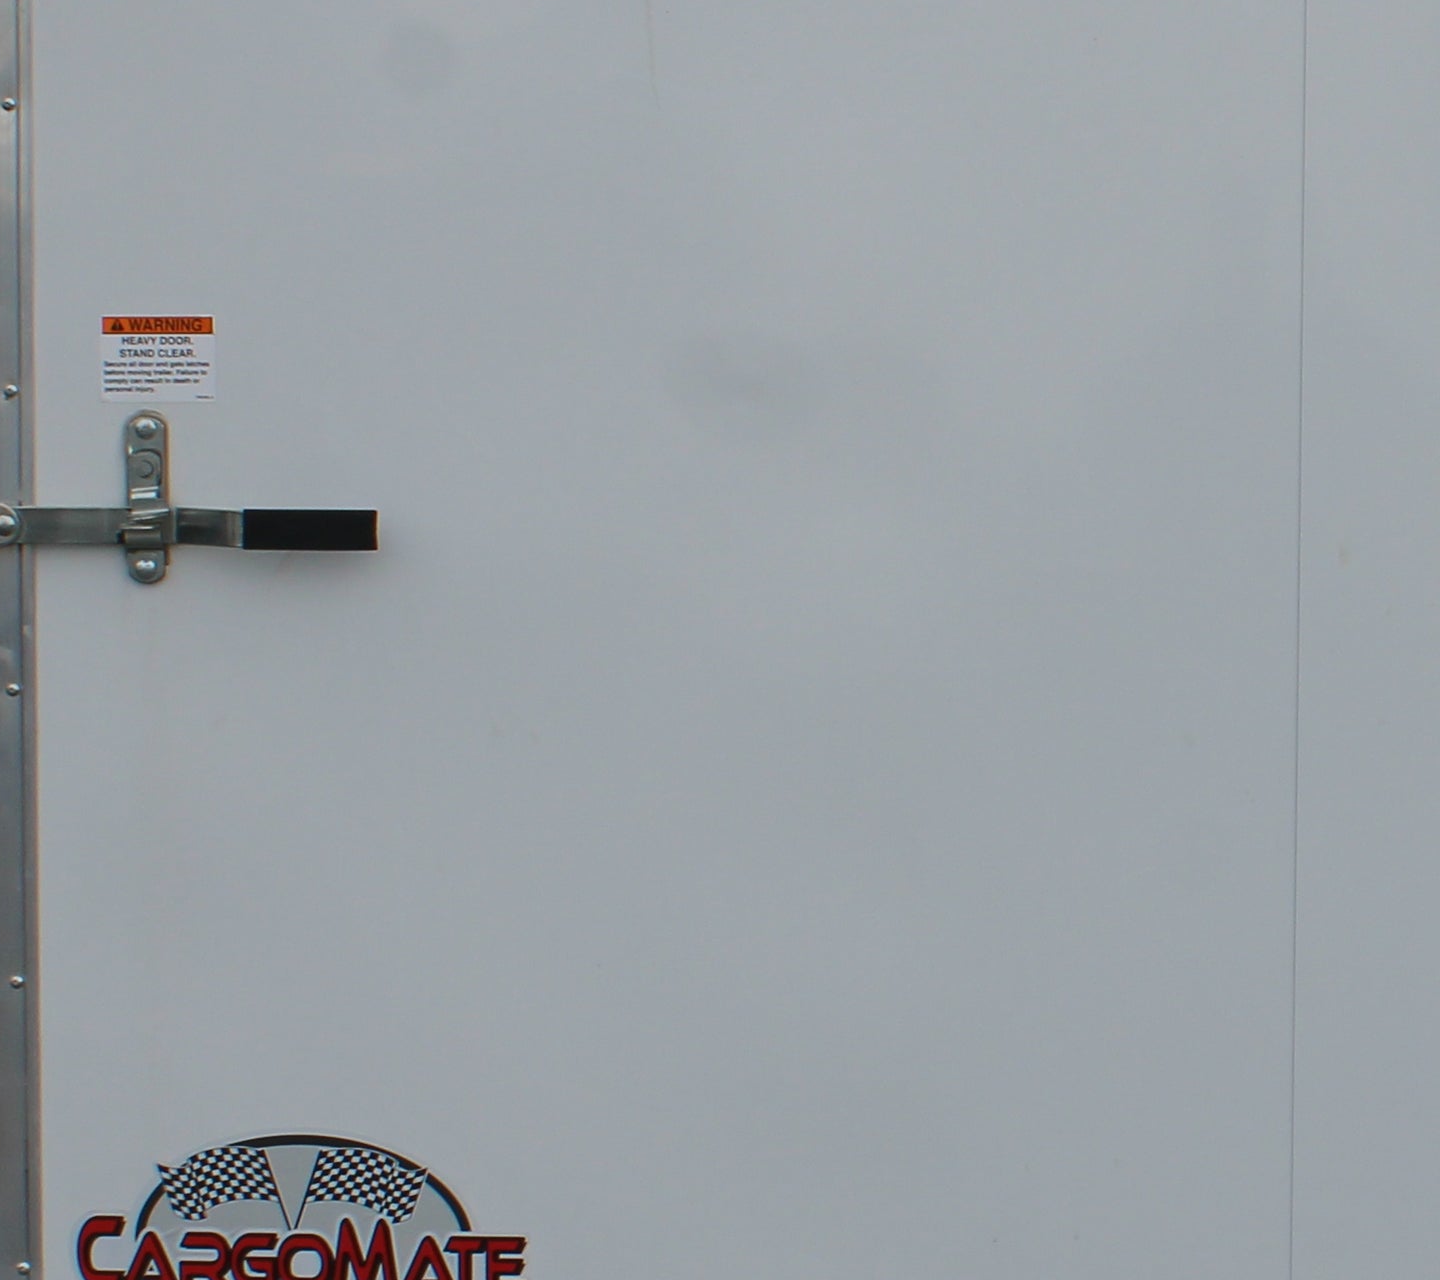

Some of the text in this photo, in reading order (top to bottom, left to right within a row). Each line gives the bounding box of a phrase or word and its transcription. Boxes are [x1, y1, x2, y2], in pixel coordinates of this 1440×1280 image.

[128, 319, 202, 332] WARNING
[121, 337, 194, 346] HEAVY DOOR.
[119, 349, 196, 358] STAND CLEAR.
